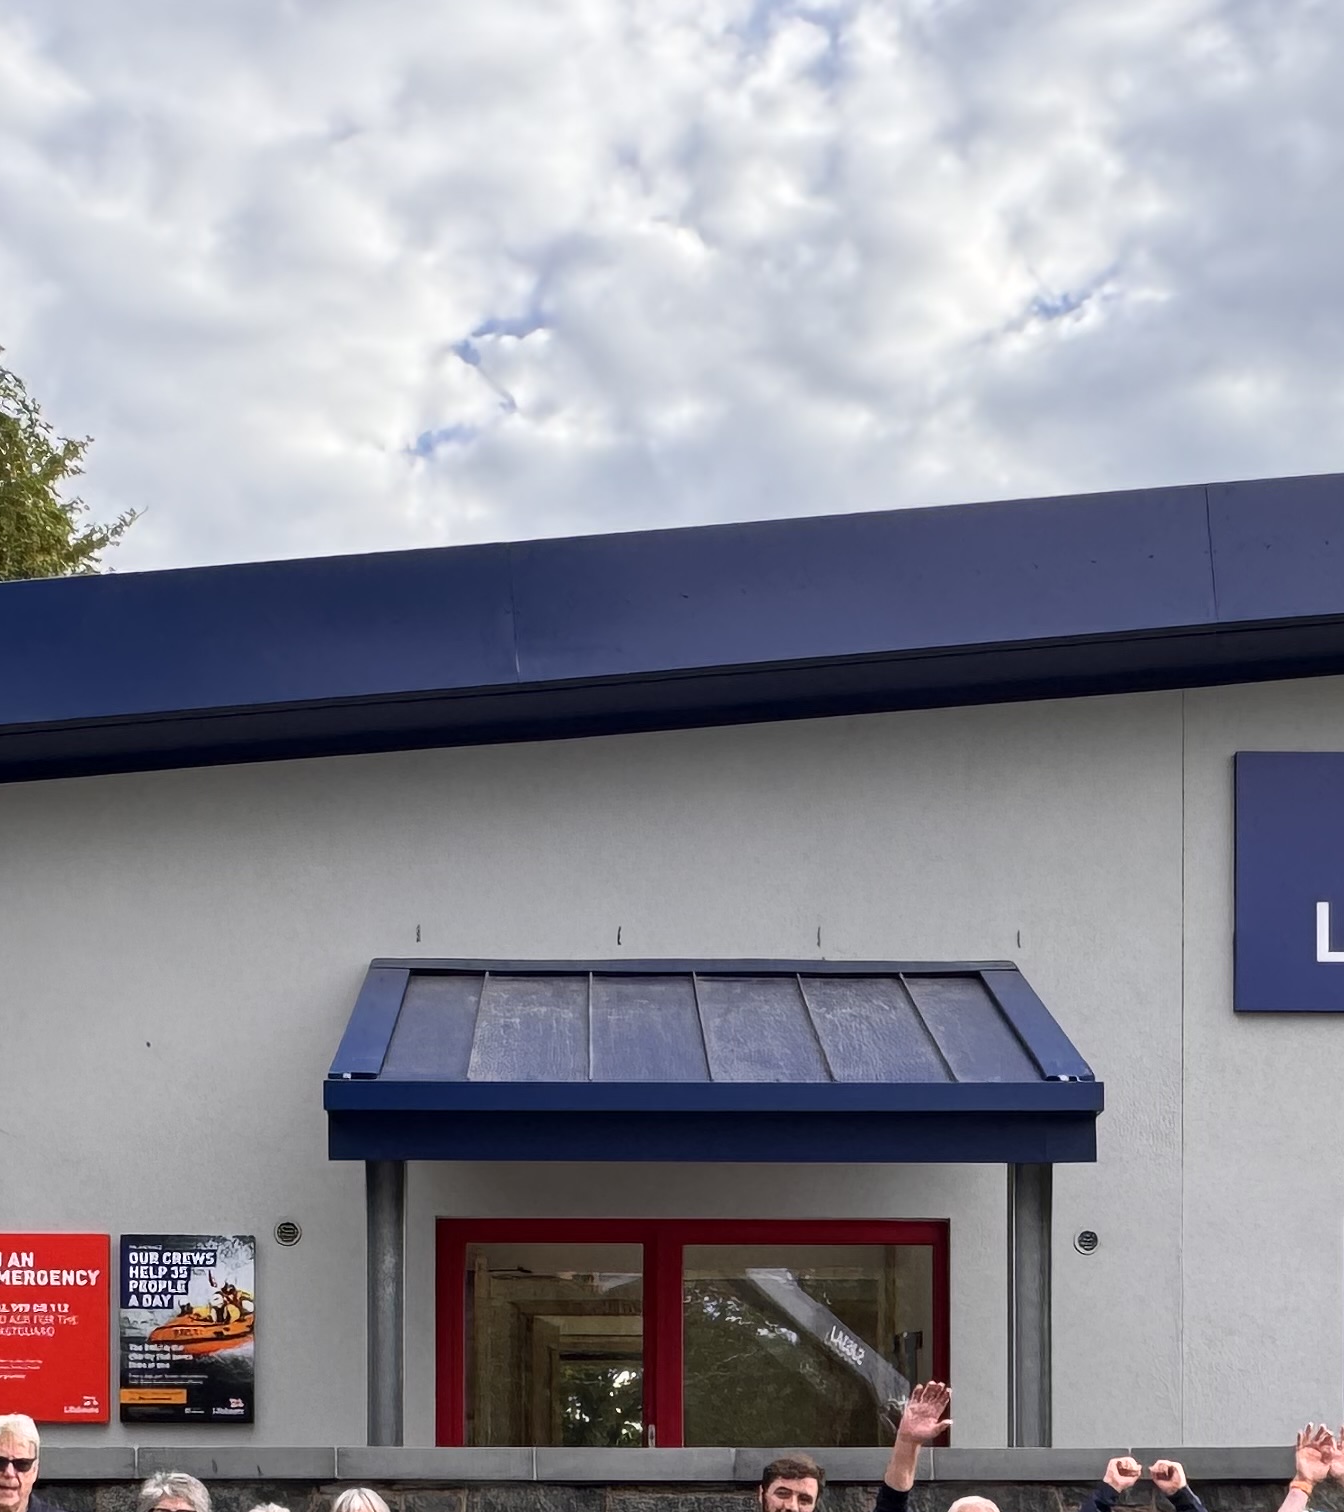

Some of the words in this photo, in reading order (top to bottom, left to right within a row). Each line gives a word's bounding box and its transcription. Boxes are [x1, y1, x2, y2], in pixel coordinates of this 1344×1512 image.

[7, 1251, 35, 1268] AN
[128, 1251, 160, 1265] OUR
[162, 1251, 215, 1265] CREWS
[129, 1265, 168, 1279] HELP
[170, 1265, 188, 1279] 35
[128, 1280, 187, 1293] PEOPLE
[128, 1294, 139, 1307] A
[142, 1294, 172, 1308] DAY
